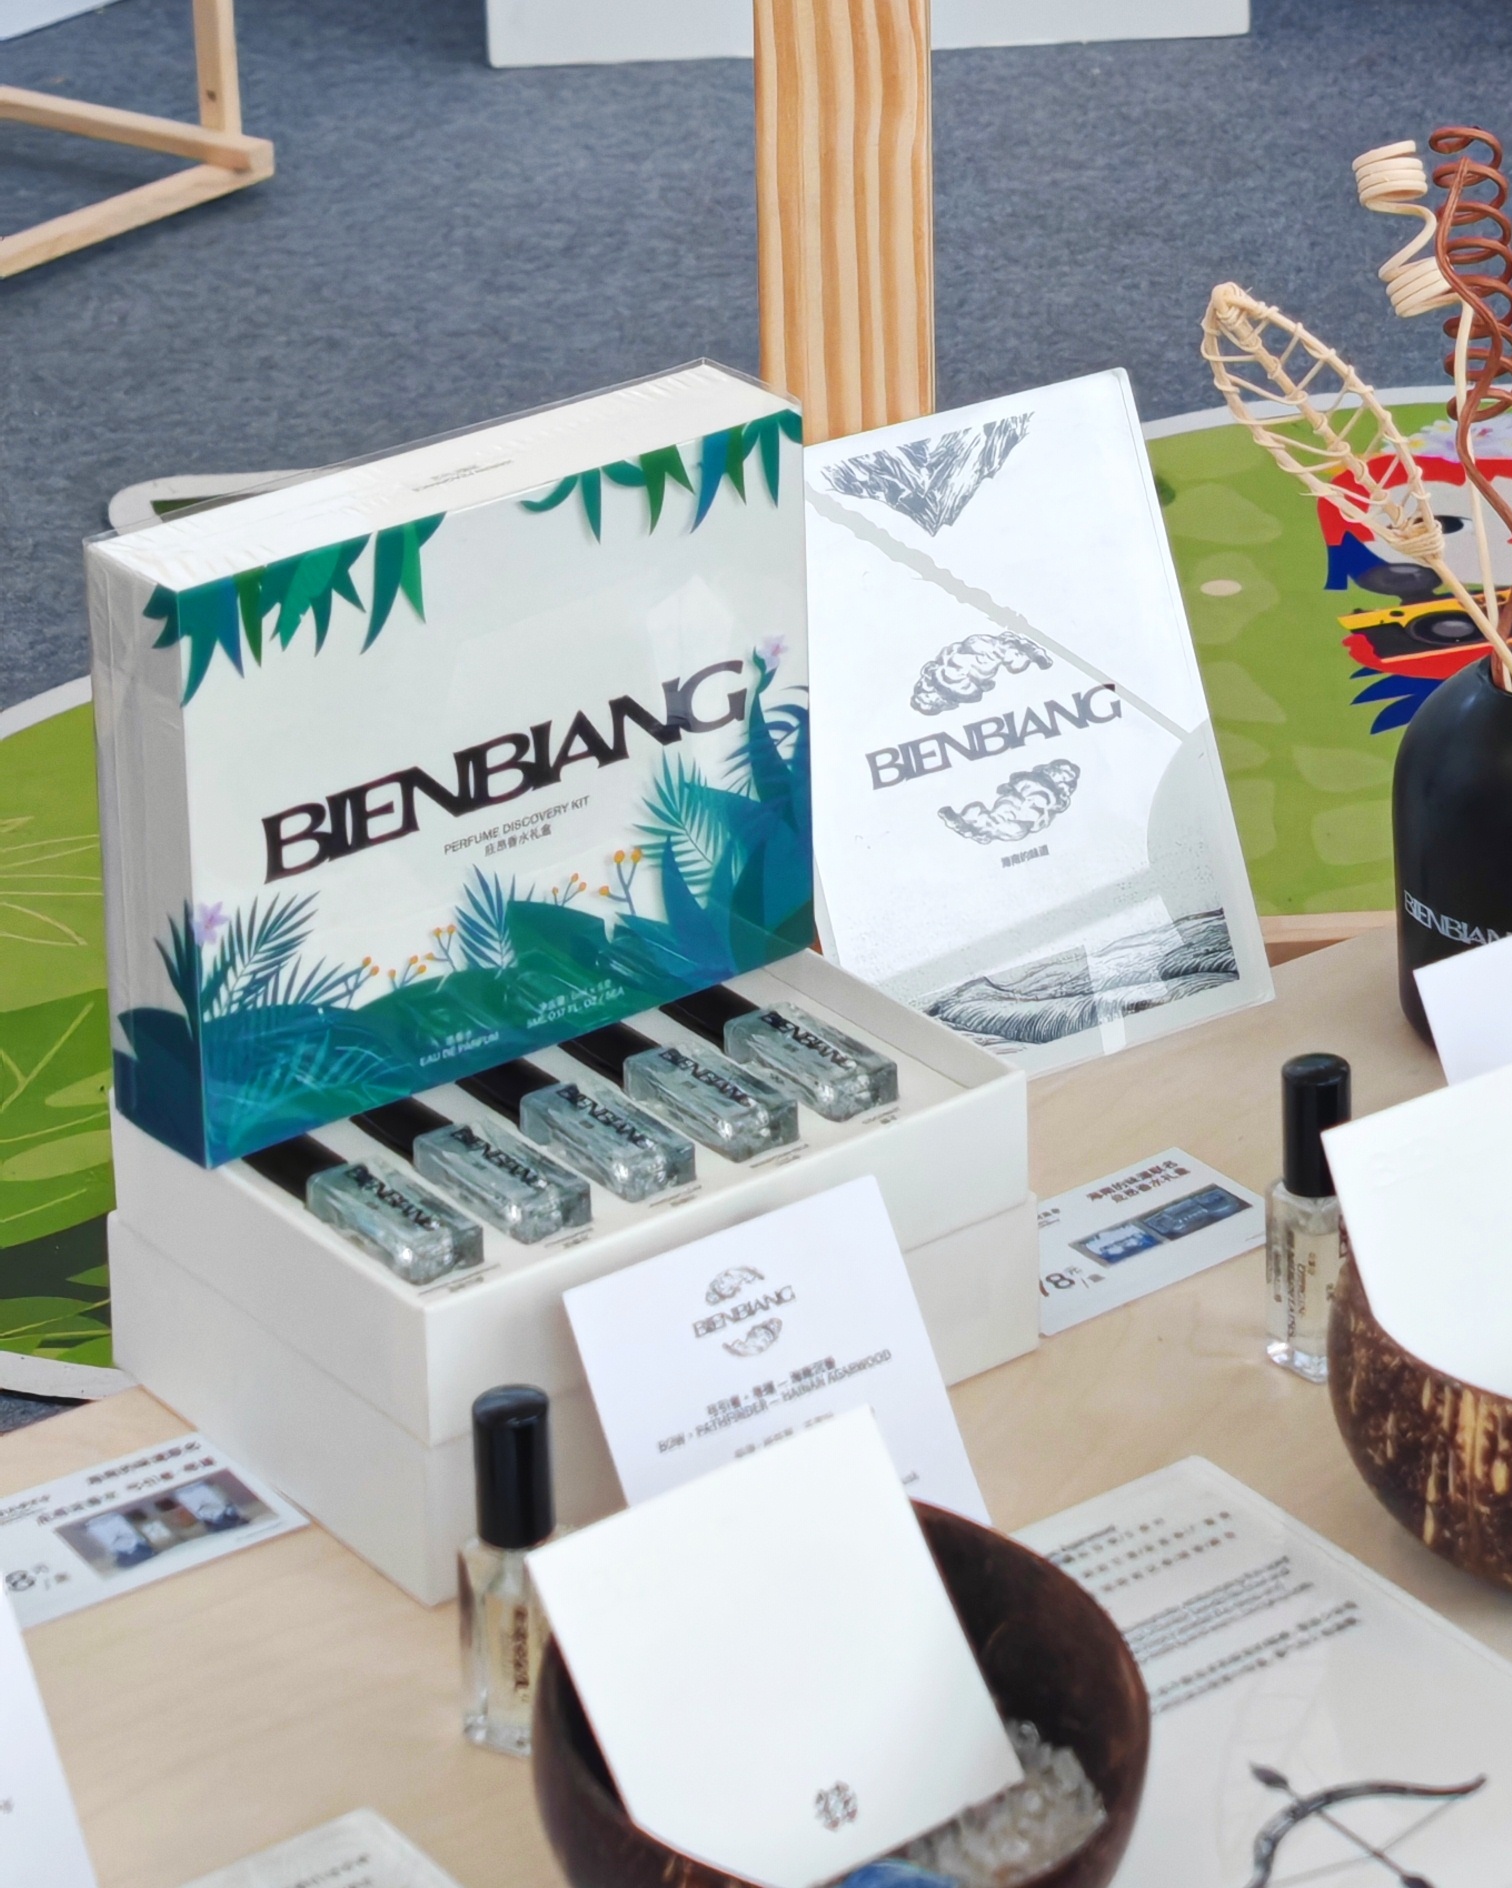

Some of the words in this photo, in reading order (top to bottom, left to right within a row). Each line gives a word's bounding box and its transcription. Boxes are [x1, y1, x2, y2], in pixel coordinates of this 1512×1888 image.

[261, 658, 749, 885] BIENBIANG
[864, 683, 1123, 791] BIENBIANG
[443, 826, 501, 855] PERFUME
[502, 802, 569, 835] DISCOVERY
[570, 795, 592, 811] KIT
[692, 1284, 797, 1339] BIENBIANG
